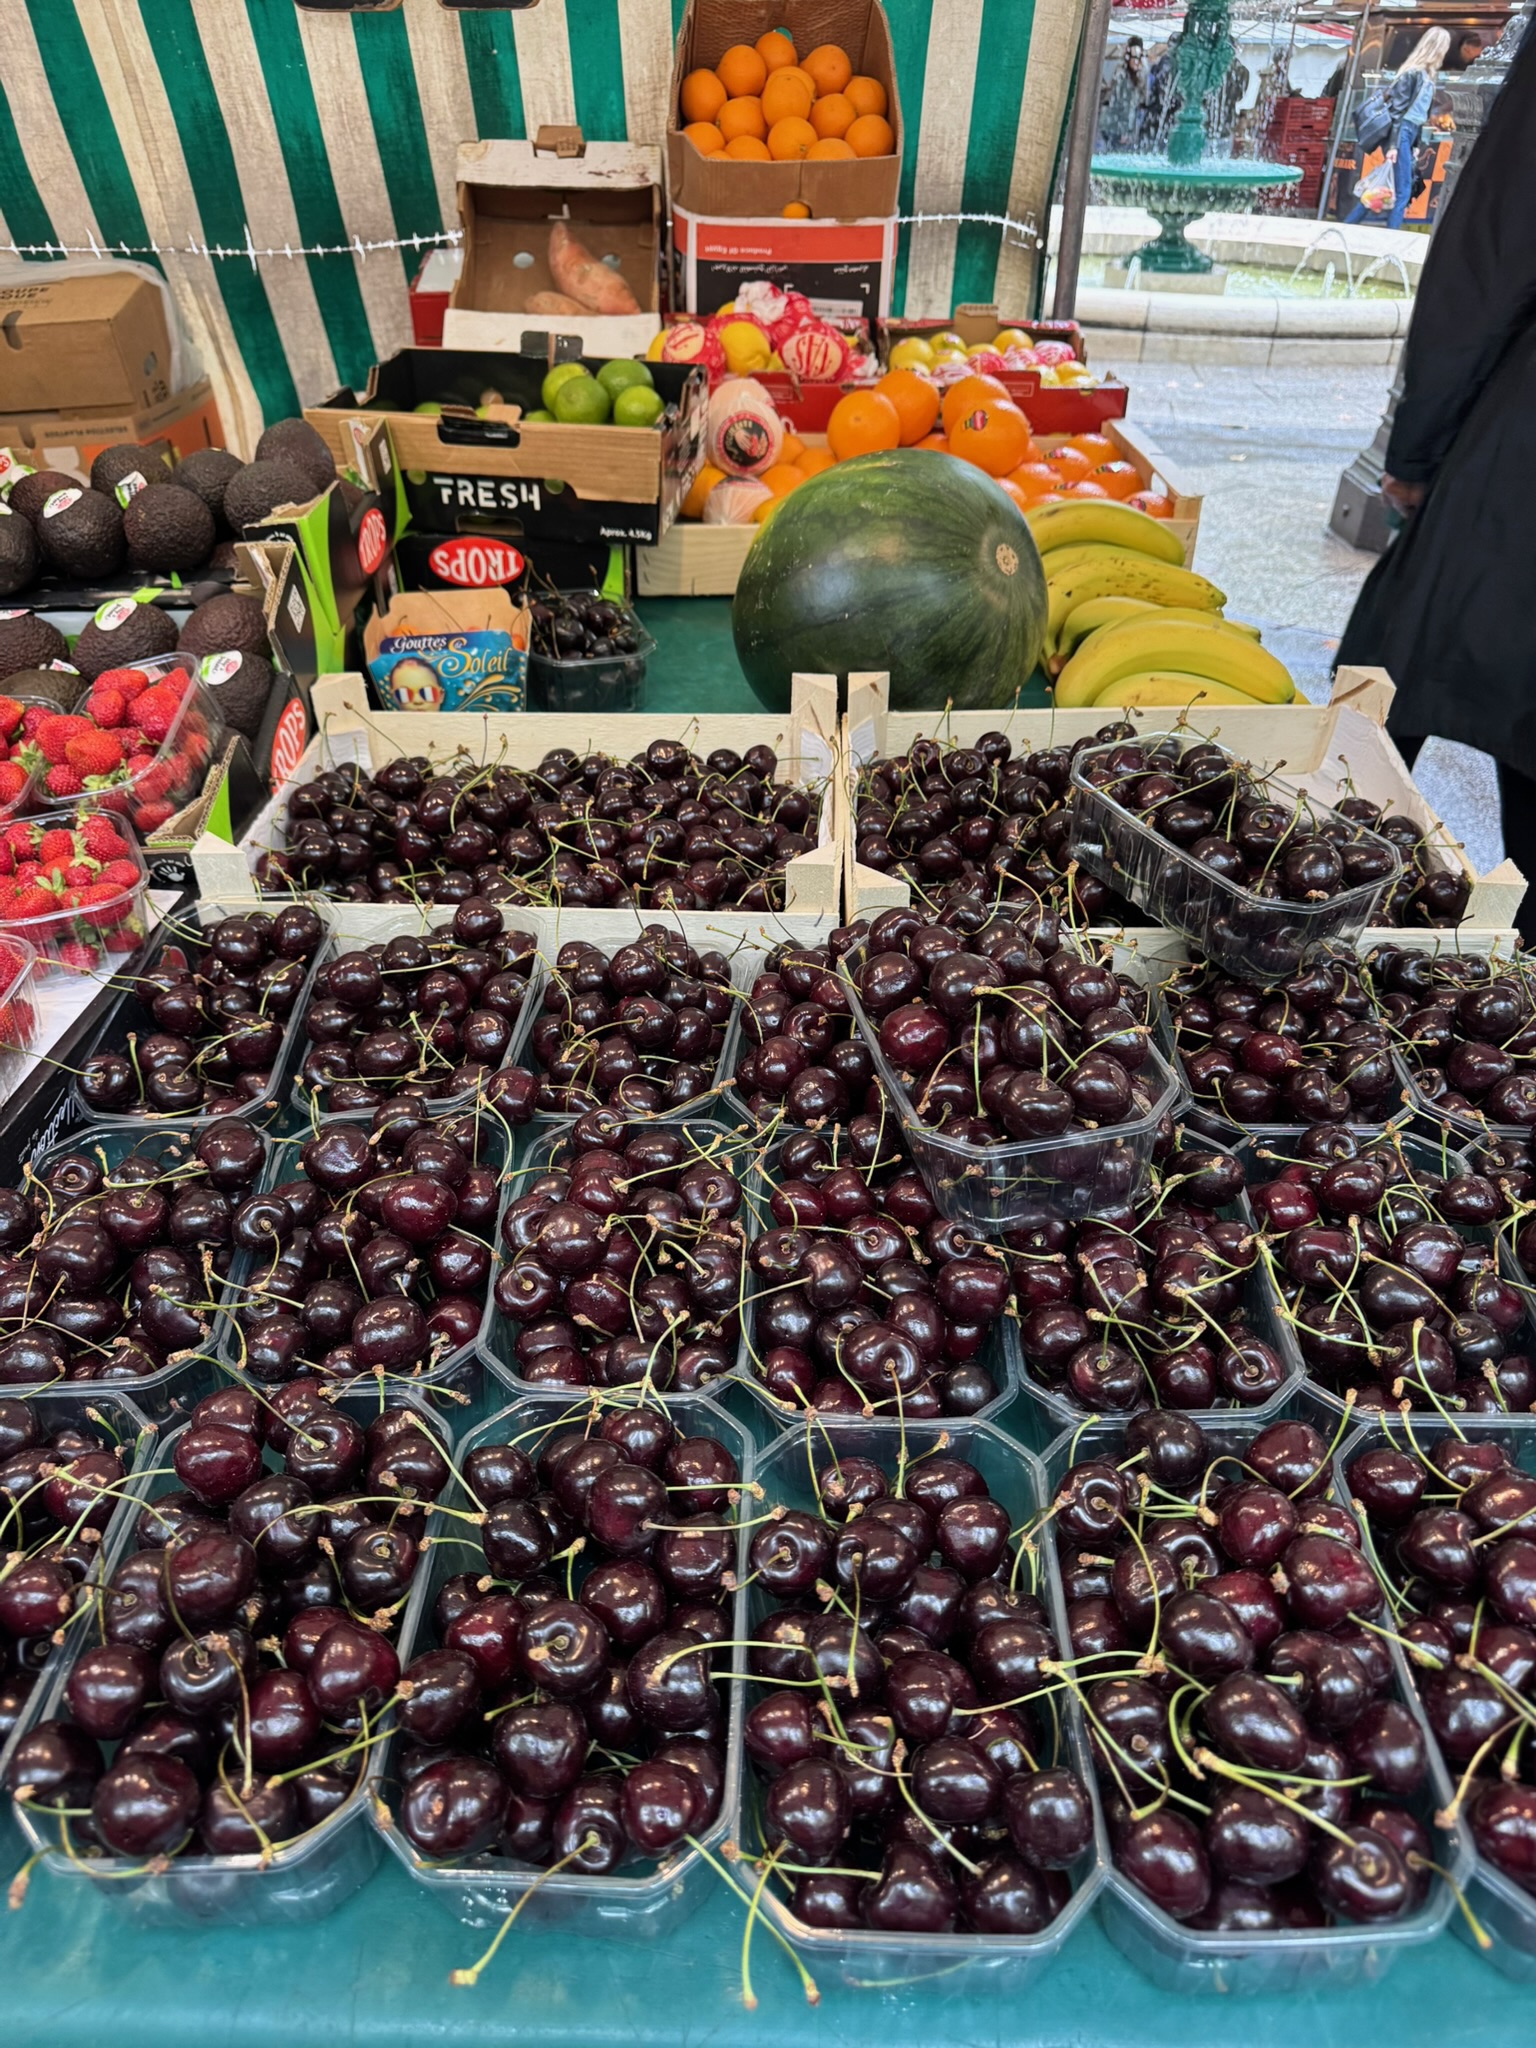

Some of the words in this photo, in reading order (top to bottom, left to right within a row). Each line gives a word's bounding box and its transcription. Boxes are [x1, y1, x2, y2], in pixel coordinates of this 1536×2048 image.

[433, 477, 541, 511] FRESH
[433, 547, 520, 585] TROPS
[390, 635, 447, 654] Gouttes
[437, 637, 513, 678] Soleil
